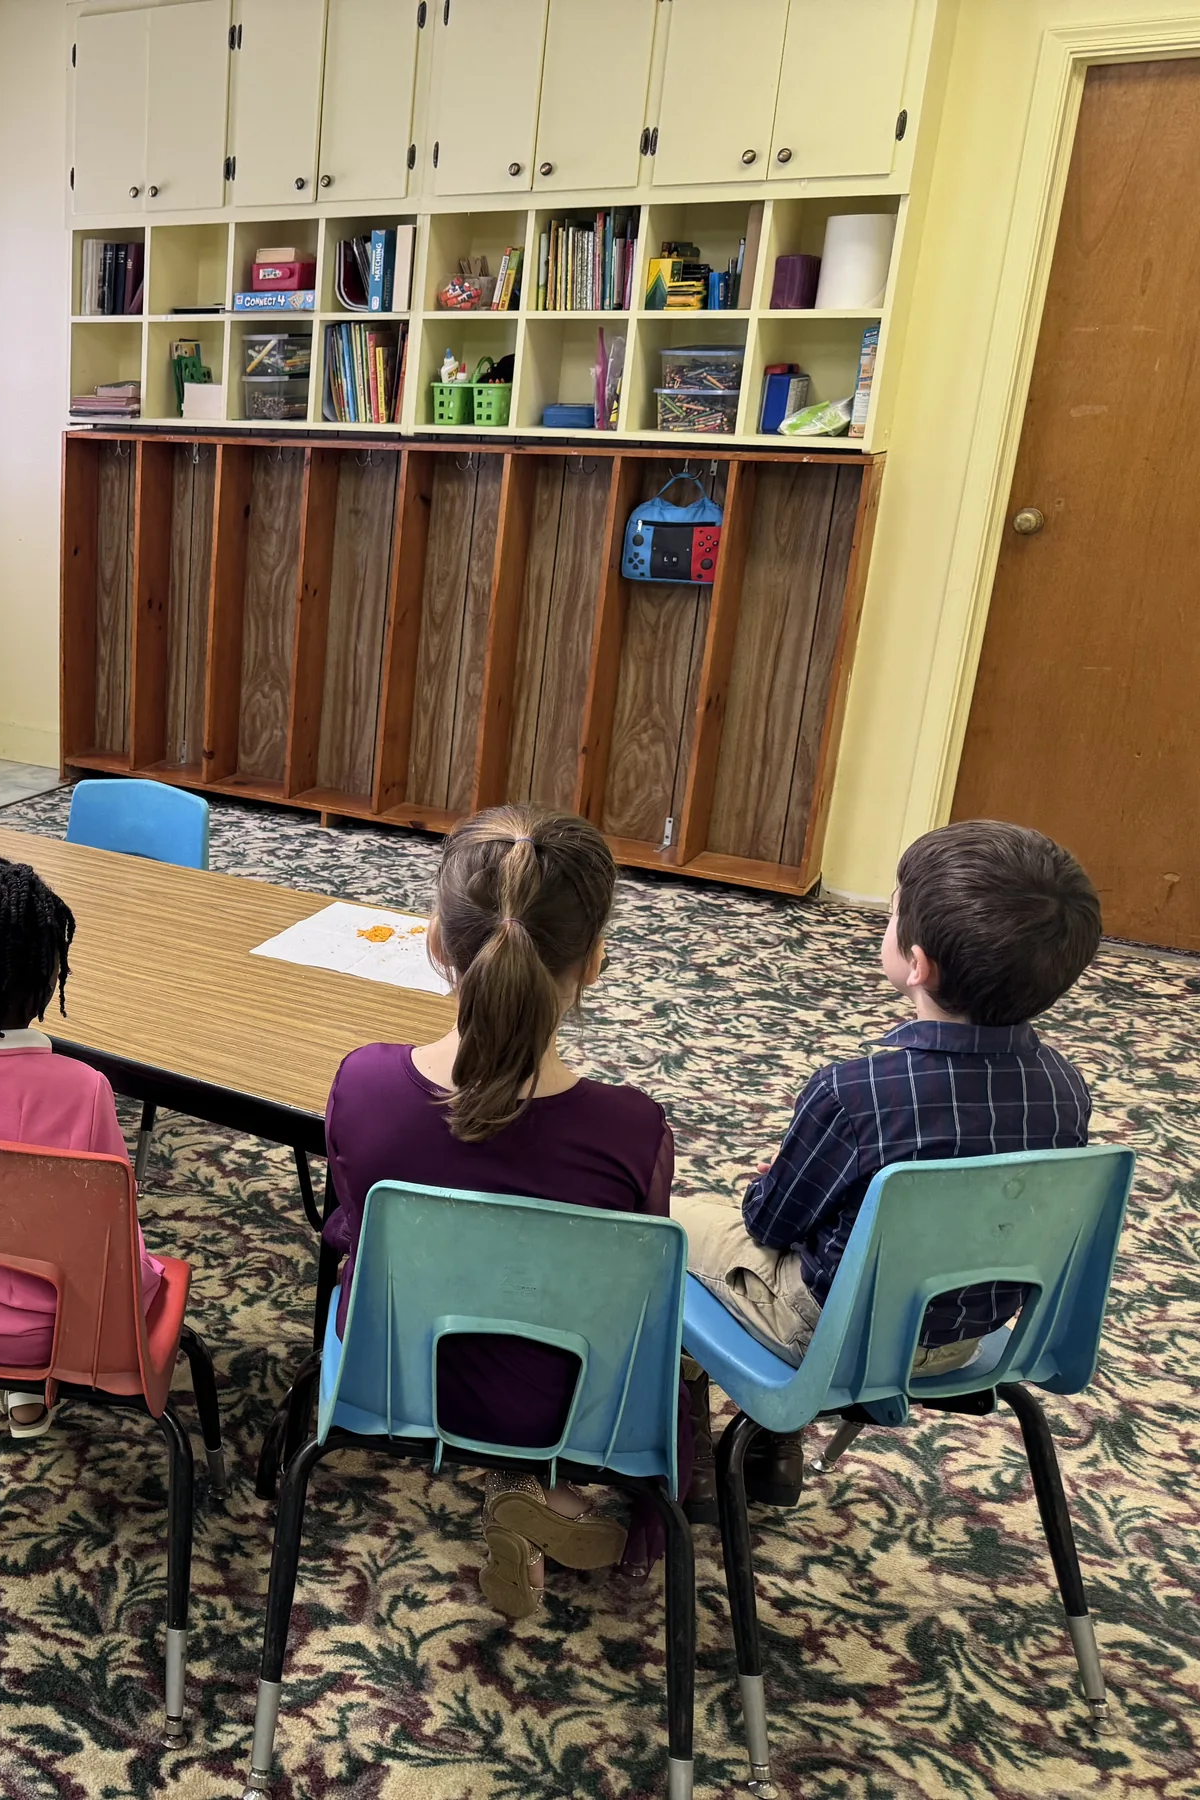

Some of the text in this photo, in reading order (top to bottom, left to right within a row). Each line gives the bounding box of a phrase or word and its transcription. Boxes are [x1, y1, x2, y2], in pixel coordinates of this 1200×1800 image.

[374, 242, 383, 281] MATCHING
[244, 296, 277, 307] CONNECT
[277, 294, 286, 307] 4
